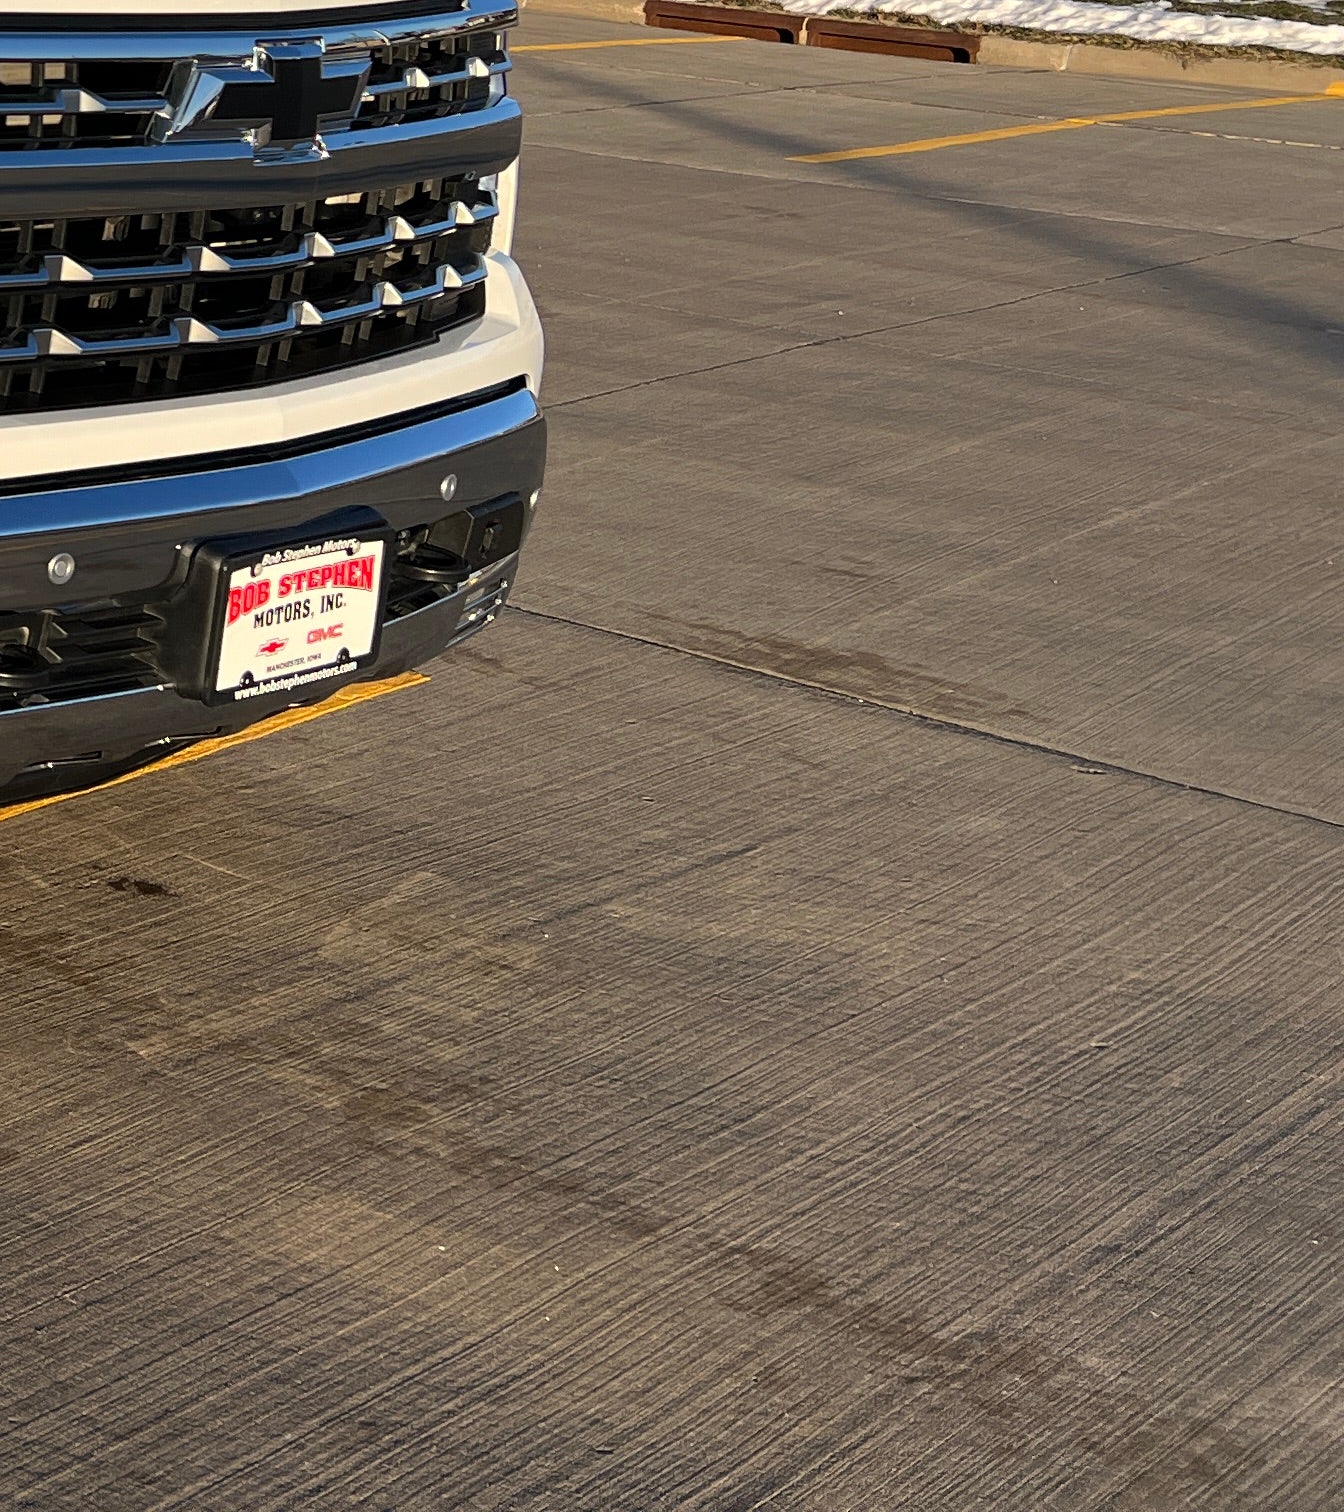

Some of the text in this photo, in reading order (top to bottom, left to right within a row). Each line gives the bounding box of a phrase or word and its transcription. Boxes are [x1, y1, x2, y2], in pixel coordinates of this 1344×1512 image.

[262, 538, 358, 567] Bob Stephen Motors
[227, 555, 376, 627] BOB STEPHEN
[253, 592, 347, 628] MOTORS, INC.
[306, 623, 344, 644] GMC
[306, 653, 322, 664] IOWA
[234, 660, 358, 700] www.bobstephenmotors.com
